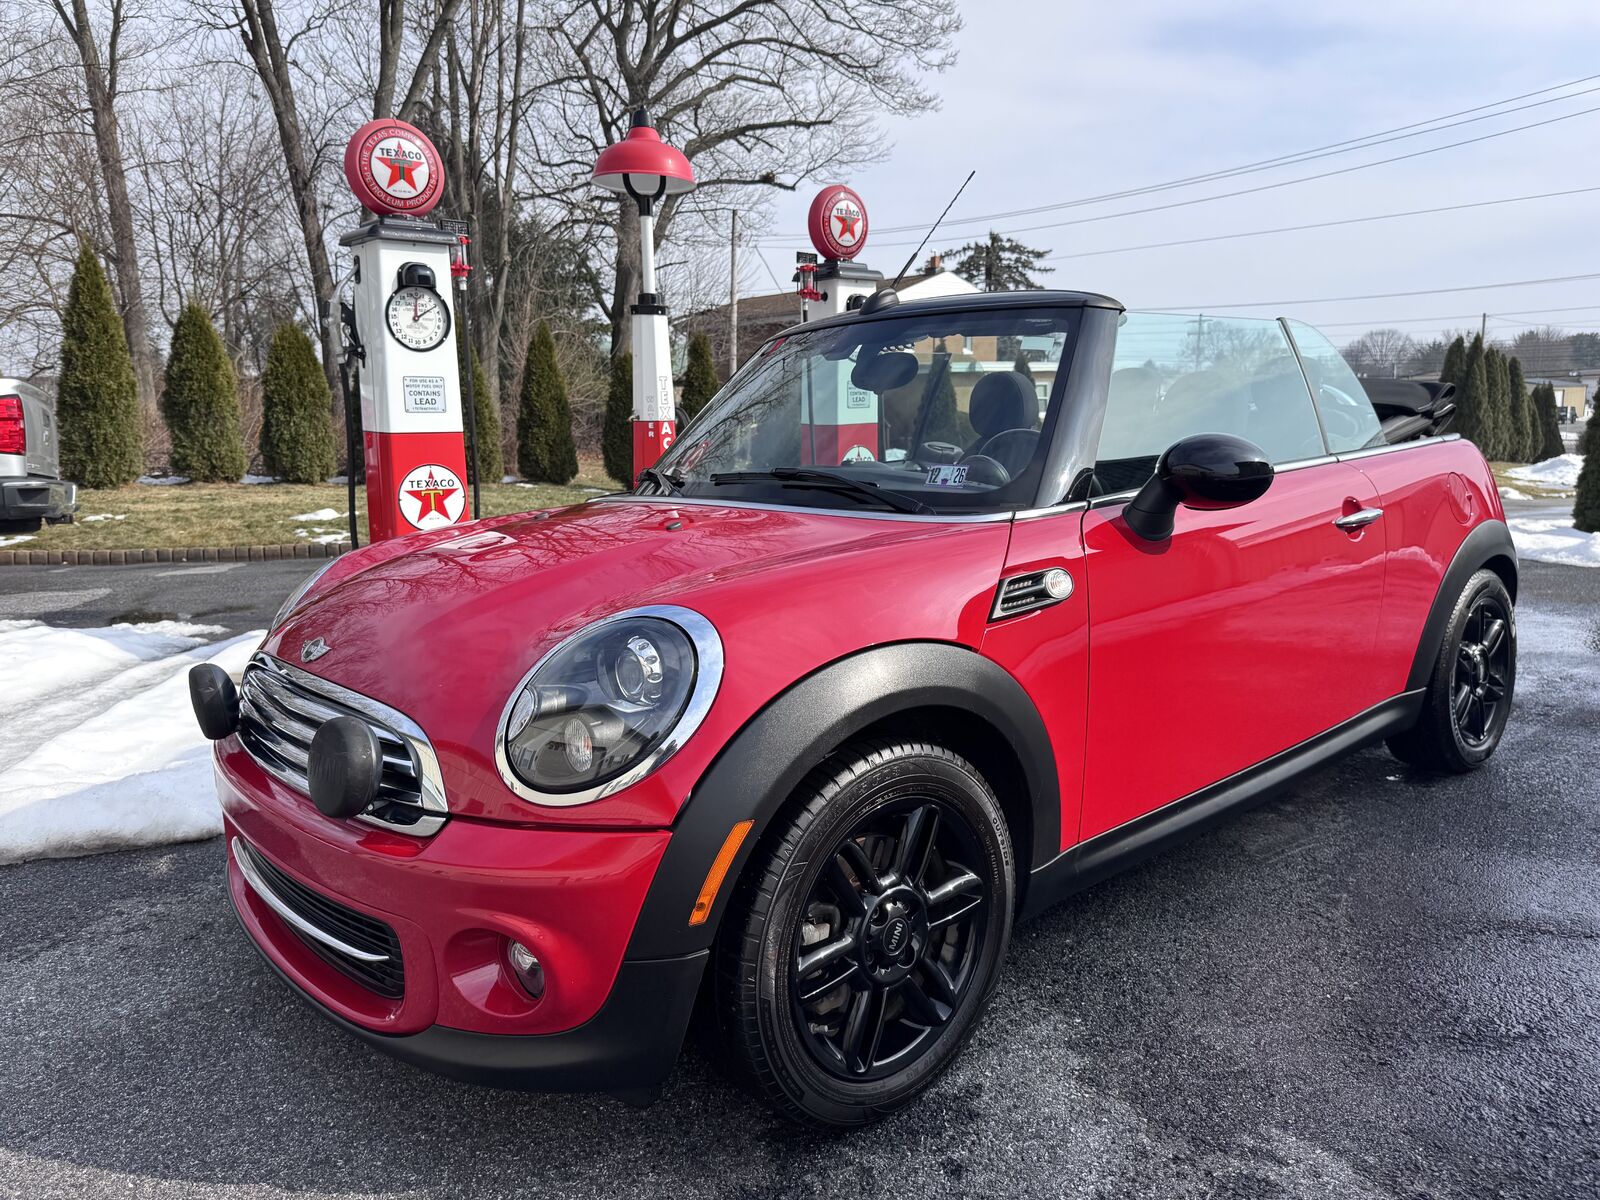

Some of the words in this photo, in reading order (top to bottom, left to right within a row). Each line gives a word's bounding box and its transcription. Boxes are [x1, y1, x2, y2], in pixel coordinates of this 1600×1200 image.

[367, 131, 388, 147] TEXAS
[380, 148, 422, 160] TEXACO
[364, 172, 405, 207] PETROLEUM
[406, 178, 436, 207] PRODUCTS
[835, 208, 860, 217] TEXACO
[929, 468, 941, 483] 12
[953, 468, 966, 483] 26
[408, 479, 455, 488] TEXACO
[993, 818, 1010, 866] OUTSIDE
[889, 922, 903, 950] MINI
